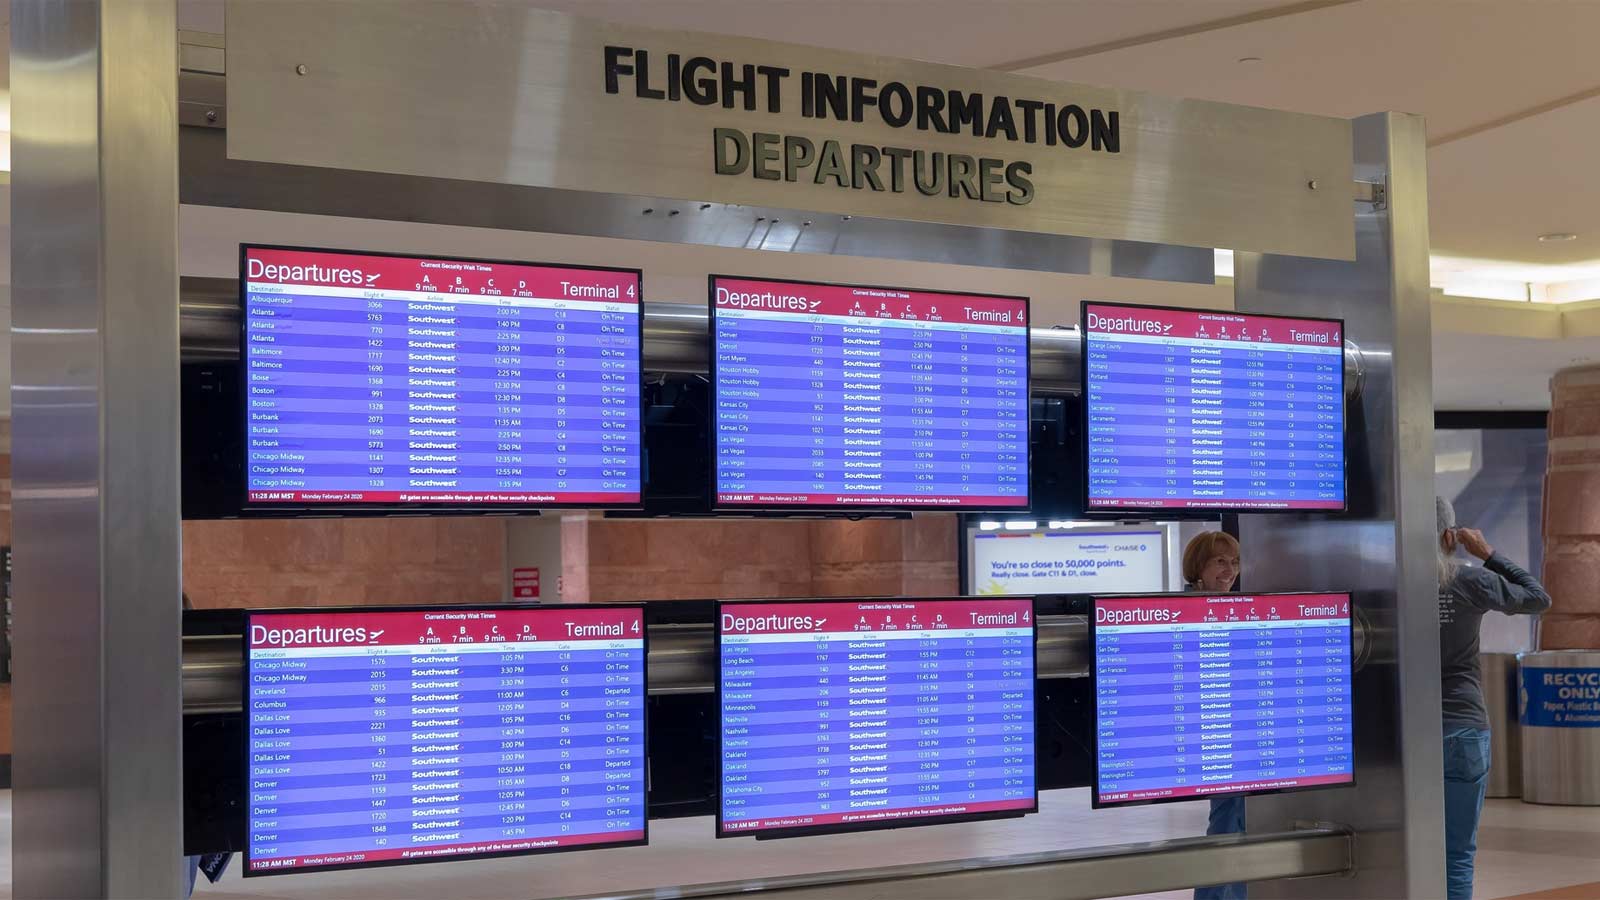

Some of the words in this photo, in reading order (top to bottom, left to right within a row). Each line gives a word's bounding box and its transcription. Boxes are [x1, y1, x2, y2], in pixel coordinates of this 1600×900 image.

[604, 46, 790, 113] FLIGHT
[801, 71, 1120, 153] INFORMATION
[713, 127, 1035, 205] DEPARTURES
[249, 258, 362, 284] Departures
[560, 282, 618, 298] Terminal
[627, 285, 635, 297] 4
[252, 296, 293, 304] Albuquerque
[408, 303, 456, 312] Southwest
[716, 288, 807, 310] Departures
[252, 308, 275, 316] Atlanta
[408, 316, 456, 324] Southwest
[964, 308, 1011, 322] Terminal
[1017, 310, 1024, 321] 4
[1088, 313, 1161, 332] Departures
[408, 328, 456, 336] Southwest
[1290, 330, 1328, 343] Terminal
[1334, 333, 1339, 342] 4
[408, 341, 456, 349] Southwest
[280, 466, 305, 474] Midway
[280, 479, 305, 487] Midway
[991, 561, 1017, 569] You're
[1066, 560, 1095, 568] 50,000
[1097, 560, 1126, 568] points.
[1097, 608, 1169, 624] Departures
[1298, 604, 1337, 616] Terminal
[1342, 603, 1348, 614] 4
[722, 614, 812, 633] Departures
[970, 612, 1016, 624] Terminal
[1023, 611, 1029, 622] 4
[427, 627, 433, 635] A
[565, 622, 623, 636] Terminal
[632, 620, 639, 633] 4
[252, 625, 366, 646] Departures
[412, 656, 458, 664] Southwest
[282, 674, 306, 682] Midway
[412, 668, 458, 676] Southwest
[412, 694, 458, 702] Southwest
[1559, 687, 1600, 699] ONLY
